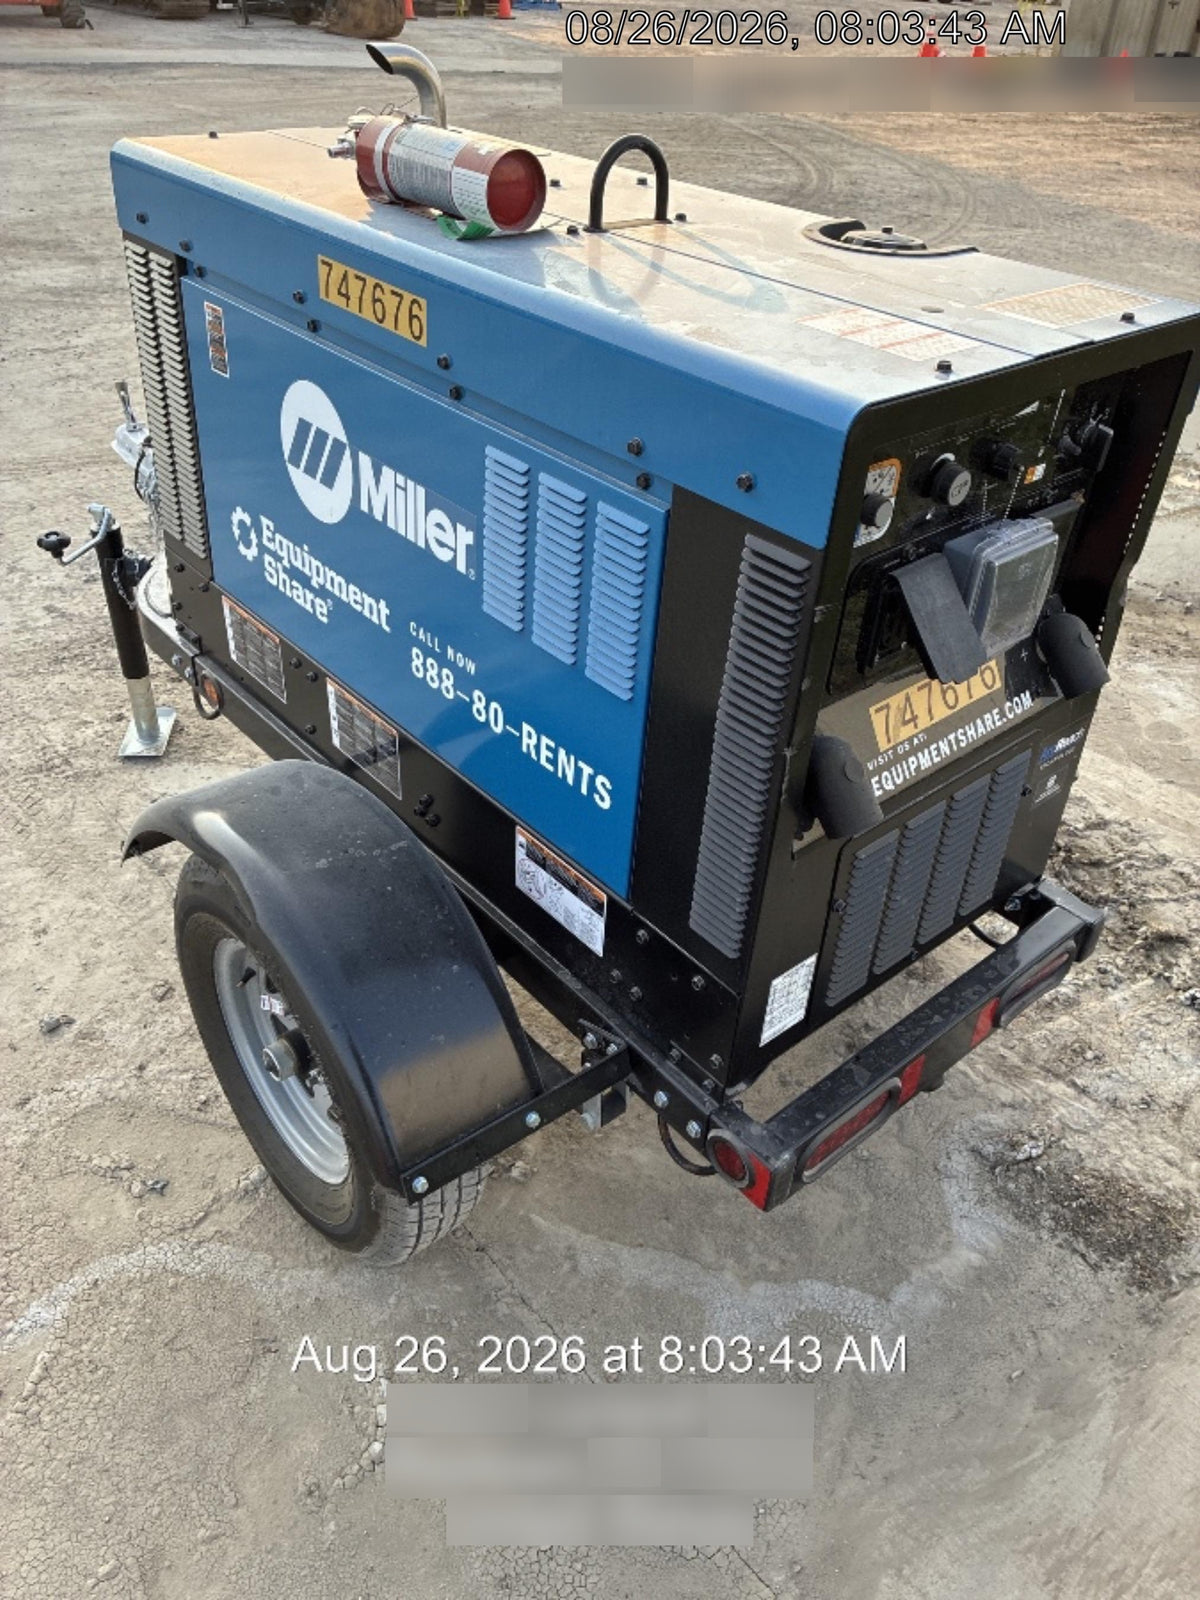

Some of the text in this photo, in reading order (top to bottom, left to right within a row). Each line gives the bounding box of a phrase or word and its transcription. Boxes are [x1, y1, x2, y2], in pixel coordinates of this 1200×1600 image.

[320, 258, 424, 342] 747676
[358, 450, 475, 575] Miller
[260, 514, 391, 633] Equipment
[263, 554, 329, 624] Share
[410, 621, 476, 676] CALL NOW
[411, 646, 613, 810] 888-80-RENTS
[866, 749, 895, 771] VISIT
[897, 741, 911, 755] US
[870, 689, 1034, 798] EQUIPMENTSHARE.COM
